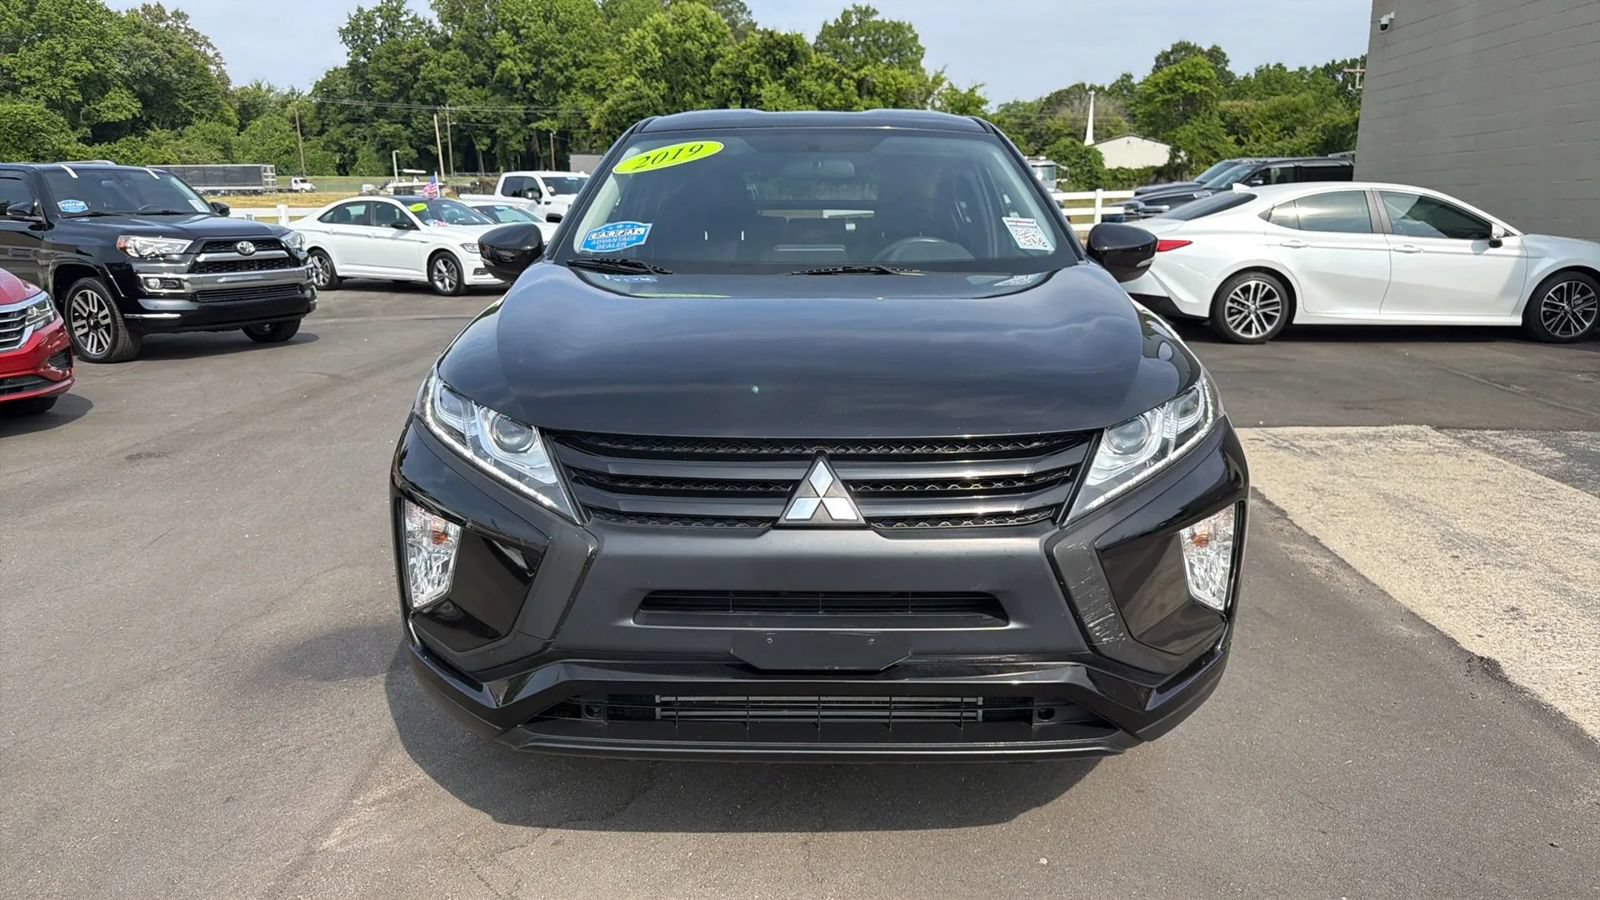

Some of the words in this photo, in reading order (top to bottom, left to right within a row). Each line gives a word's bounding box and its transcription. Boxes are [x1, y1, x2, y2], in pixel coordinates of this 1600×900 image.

[631, 144, 704, 170] 2019
[591, 235, 637, 245] ADVANTAGE
[595, 241, 628, 250] DEALER
